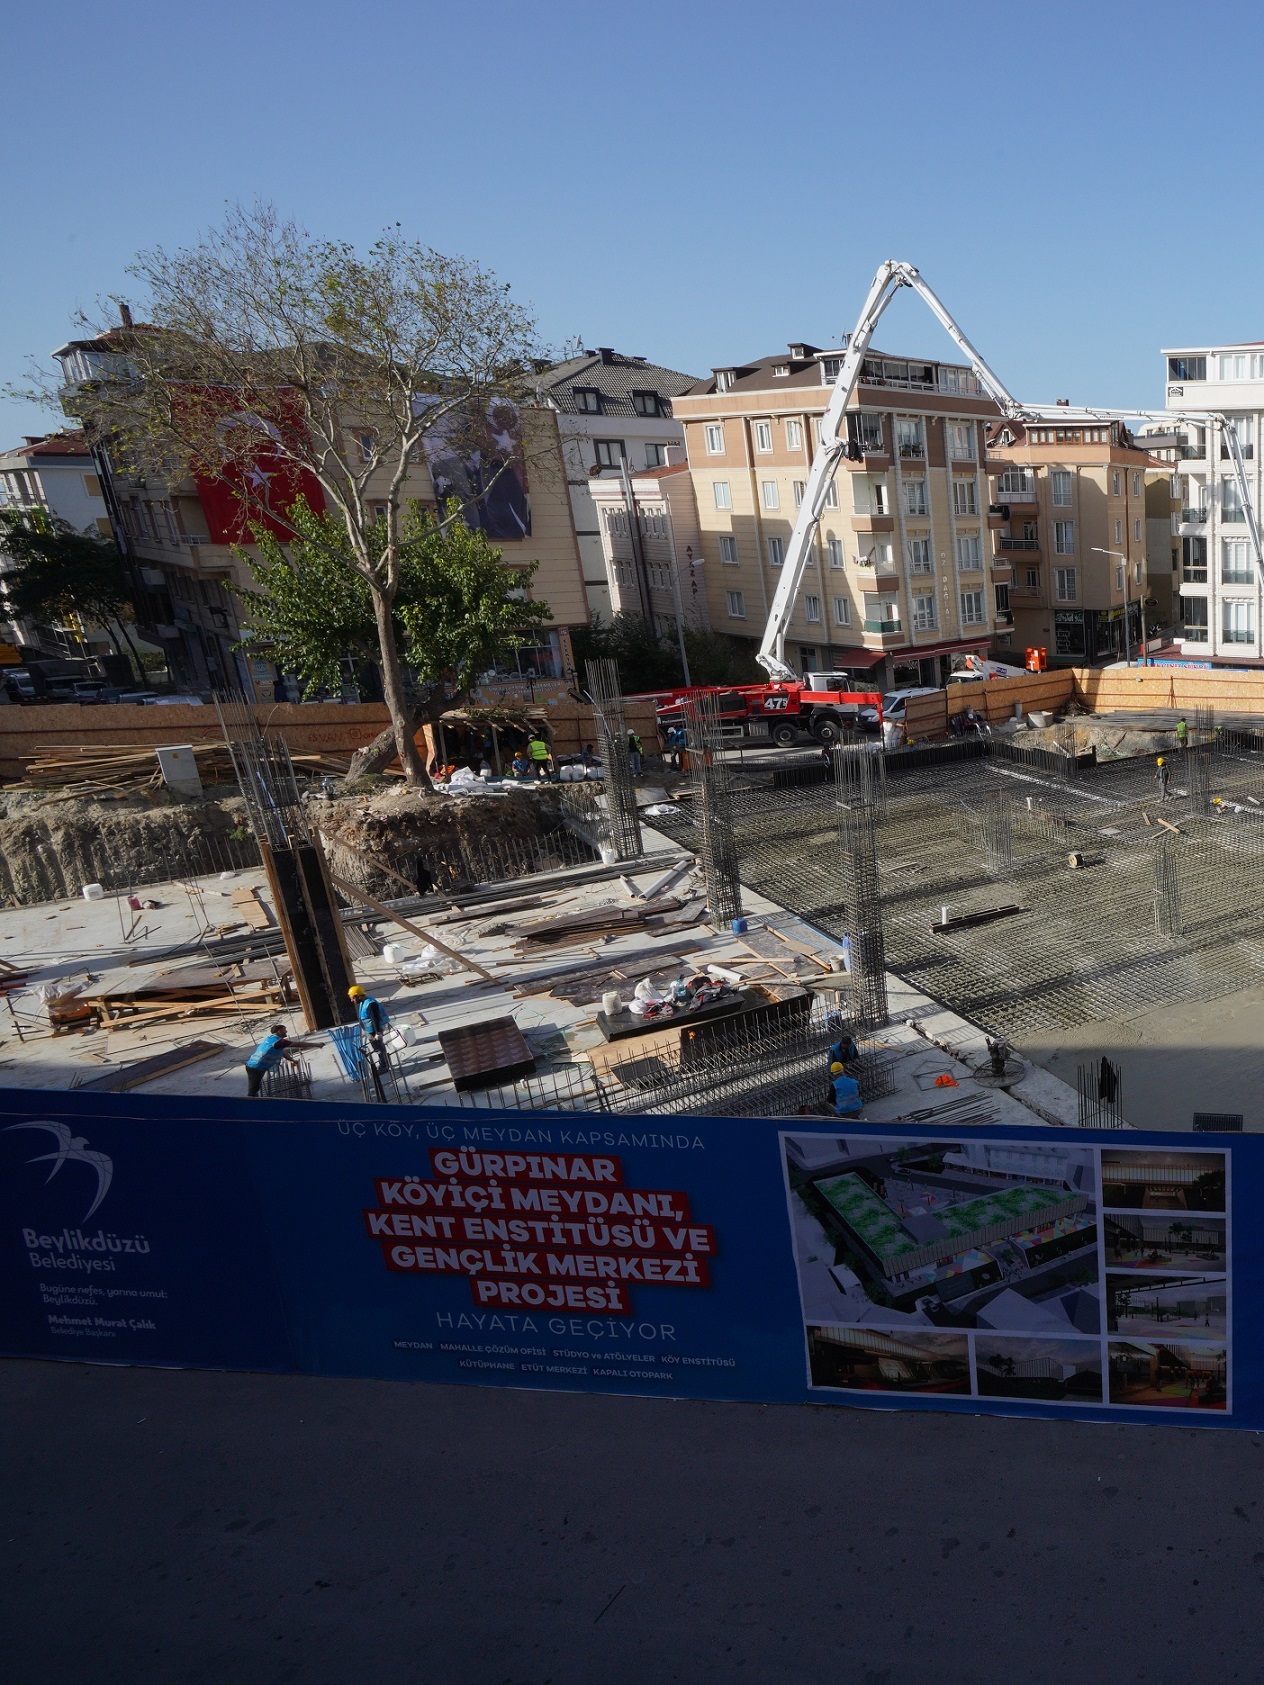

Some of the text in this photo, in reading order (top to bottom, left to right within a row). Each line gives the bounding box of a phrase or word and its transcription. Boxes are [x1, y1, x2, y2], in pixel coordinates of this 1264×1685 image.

[338, 1120, 706, 1150] ÜÇ KÖY, ÜÇ MEYDAN KAPSAMINDA
[432, 1146, 618, 1181] GÜRPINAR
[380, 1175, 684, 1222] KÖYİÇİ MEYDANI,
[22, 1228, 151, 1253] Beylikdüzü
[368, 1213, 712, 1251] KENT ENSTİTÜSÜ VE
[29, 1252, 116, 1274] Belediyesi
[390, 1244, 701, 1282] GENÇLİK MERKEZİ
[40, 1282, 76, 1295] Bugüne
[77, 1284, 105, 1297] nefes,
[476, 1280, 623, 1310] PROJESİ
[47, 1314, 157, 1331] Mehmet Murat Çalık
[436, 1311, 677, 1341] HAYATA GEÇİYOR
[393, 1339, 736, 1368] MEYDAN MAHALLE ÇÖZÜM OFİSİ STÜDYO ve ATÖLYELER KÖY ENSTİTÜSÜ
[459, 1359, 674, 1380] KÜTÜPHANE ETÜT MERKEZİ KAPALI OTOPARK
